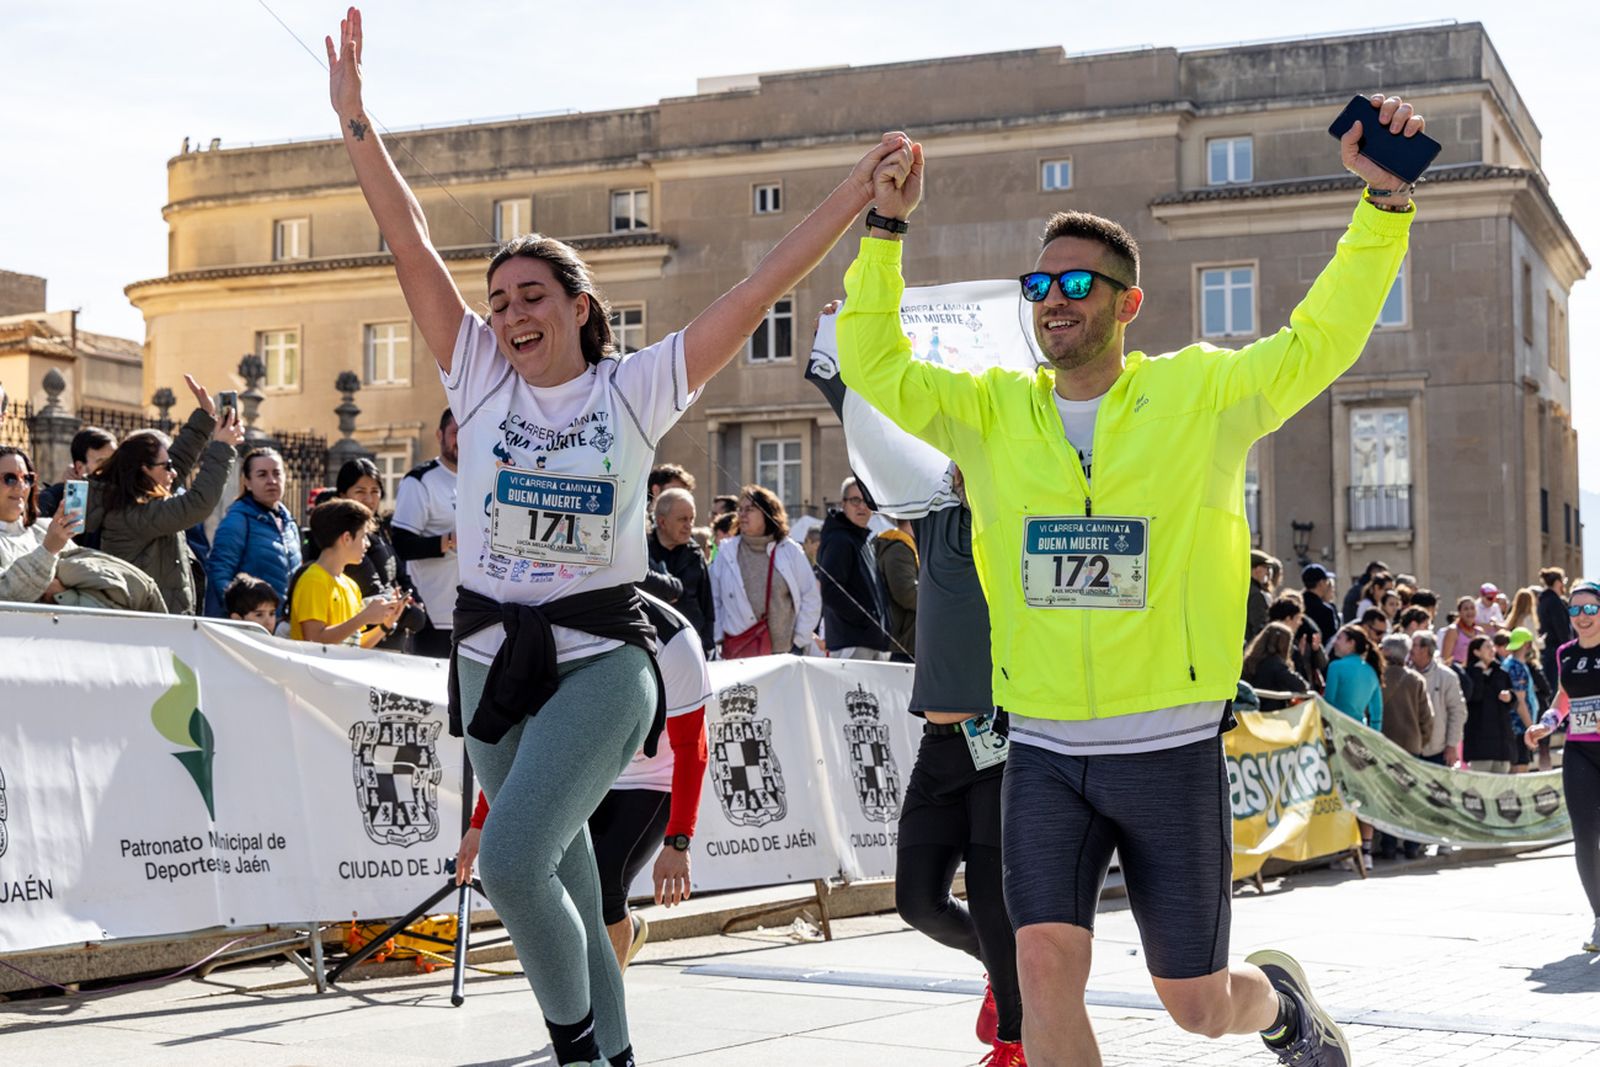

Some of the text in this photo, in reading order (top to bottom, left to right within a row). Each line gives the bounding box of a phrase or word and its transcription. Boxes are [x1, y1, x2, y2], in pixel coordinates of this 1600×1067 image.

[936, 304, 982, 312] CAMINATA
[923, 313, 964, 325] MUERTE
[510, 476, 603, 494] VI CARRERA CAMINATA
[508, 489, 582, 509] BUENA MUERTE
[528, 509, 576, 544] 171
[1040, 523, 1131, 534] VI CARRERA CAMINATA
[1038, 537, 1110, 551] BUENA MUERTE
[1053, 555, 1110, 588] 172
[120, 836, 203, 858] Patronato
[267, 833, 286, 850] de
[706, 829, 817, 857] CIUDAD DE JAÉN
[850, 833, 887, 848] CIUDAD
[145, 856, 221, 883] Deportes
[235, 855, 271, 874] Jaén
[339, 859, 404, 880] CIUDAD
[408, 858, 430, 876] DE
[0, 874, 54, 903] JAÉN
